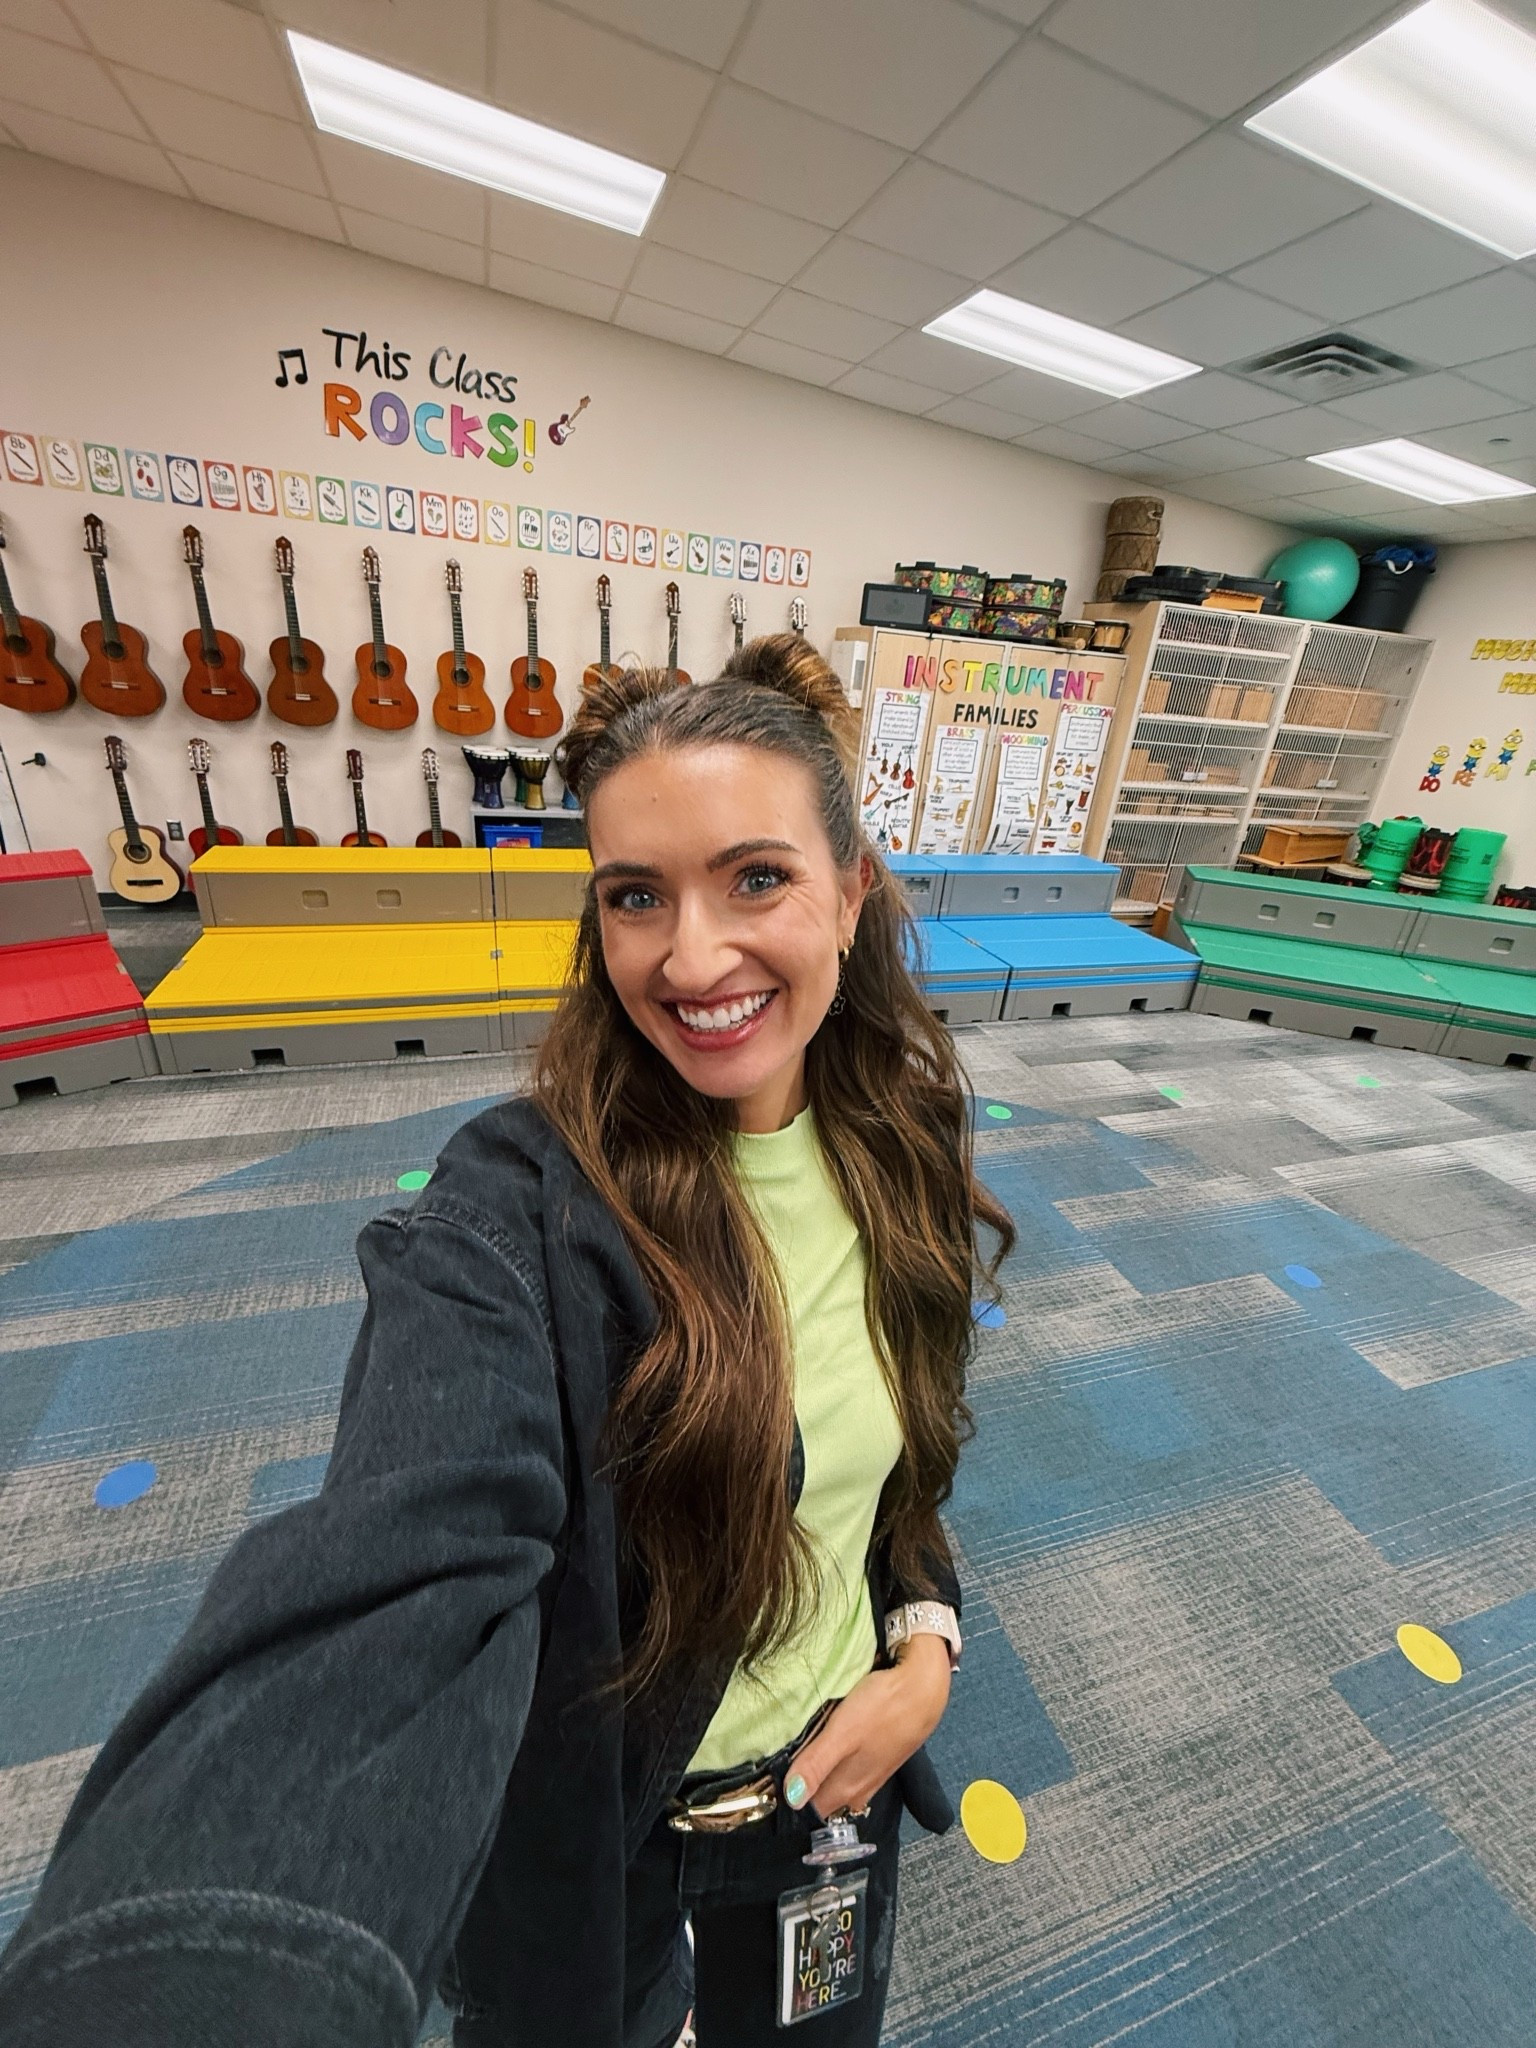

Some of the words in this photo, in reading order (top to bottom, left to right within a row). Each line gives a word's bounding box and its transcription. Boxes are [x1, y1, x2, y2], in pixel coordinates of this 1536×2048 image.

[322, 328, 411, 381] This
[429, 345, 518, 403] Class
[323, 382, 536, 474] ROCKS!
[94, 448, 110, 461] Dd
[213, 465, 228, 481] Gg
[359, 487, 372, 499] Kk
[426, 497, 442, 508] Mm
[524, 510, 536, 524] Pp
[1470, 638, 1536, 661] MUSI
[904, 654, 1104, 702] INSTRUMENT
[953, 703, 1039, 729] FAMILIES
[1061, 703, 1114, 718] PERCUSSION
[946, 727, 975, 739] BRASS
[1419, 776, 1441, 793] DO
[1452, 769, 1477, 788] RE
[796, 1980, 847, 2014] HERE
